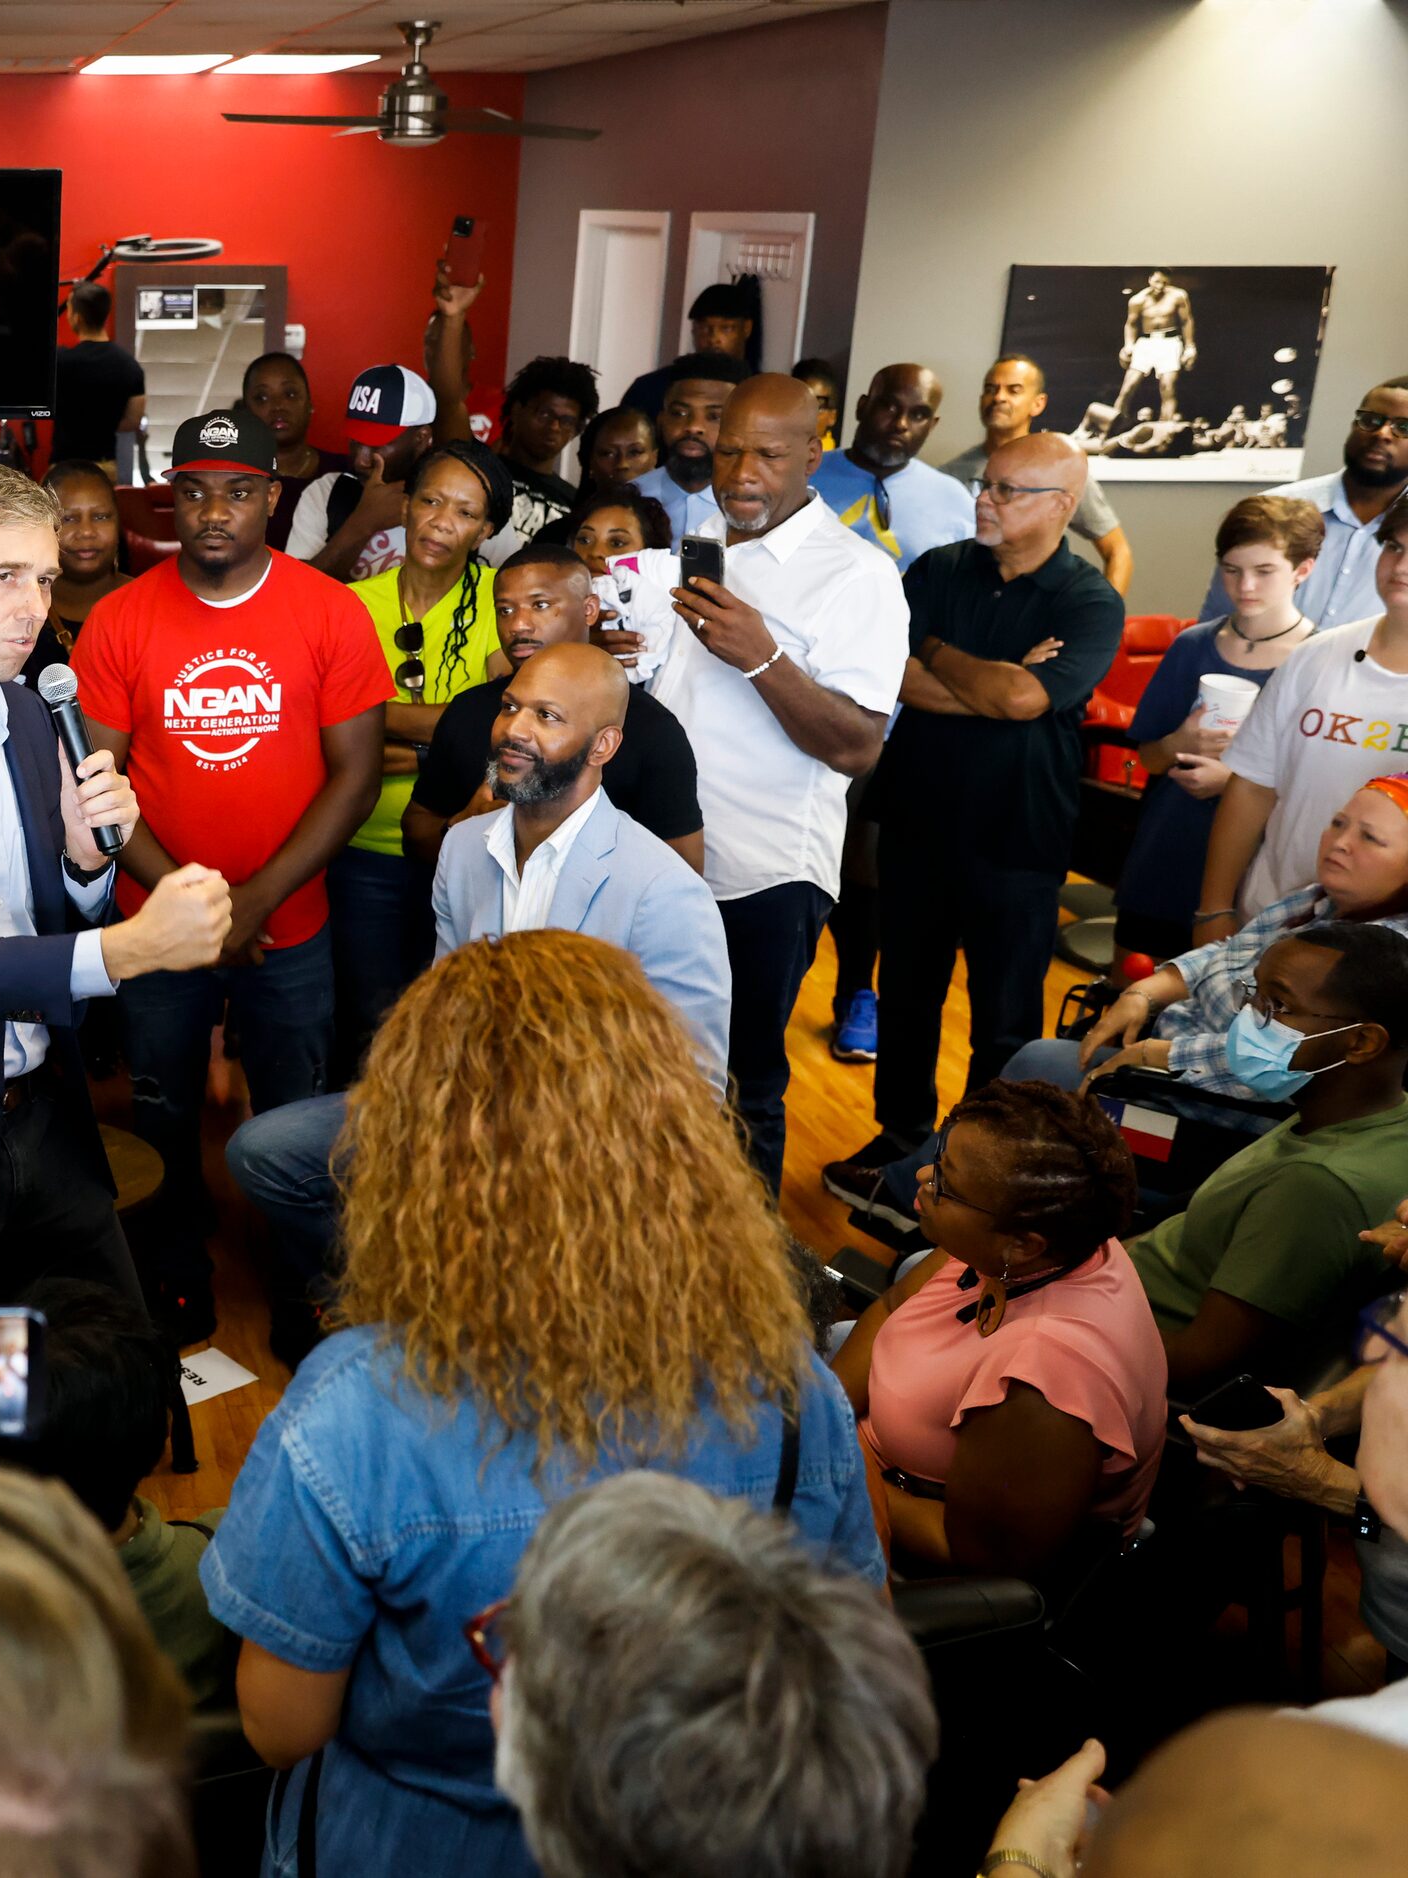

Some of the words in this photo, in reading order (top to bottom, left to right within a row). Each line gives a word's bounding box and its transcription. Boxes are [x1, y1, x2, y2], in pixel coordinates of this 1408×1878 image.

[348, 385, 382, 414] USA
[200, 427, 239, 438] NGAN
[174, 649, 224, 687] JUSTICE
[229, 648, 257, 662] FOR
[256, 661, 275, 683] ALL
[164, 683, 282, 717] NGAN
[164, 719, 196, 729] NEXT
[201, 714, 280, 729] GENERATION
[210, 727, 240, 737] ACTION
[240, 723, 279, 735] NETWORK
[196, 759, 219, 771] EST.
[223, 756, 248, 771] 2014
[180, 1364, 208, 1386] RES
